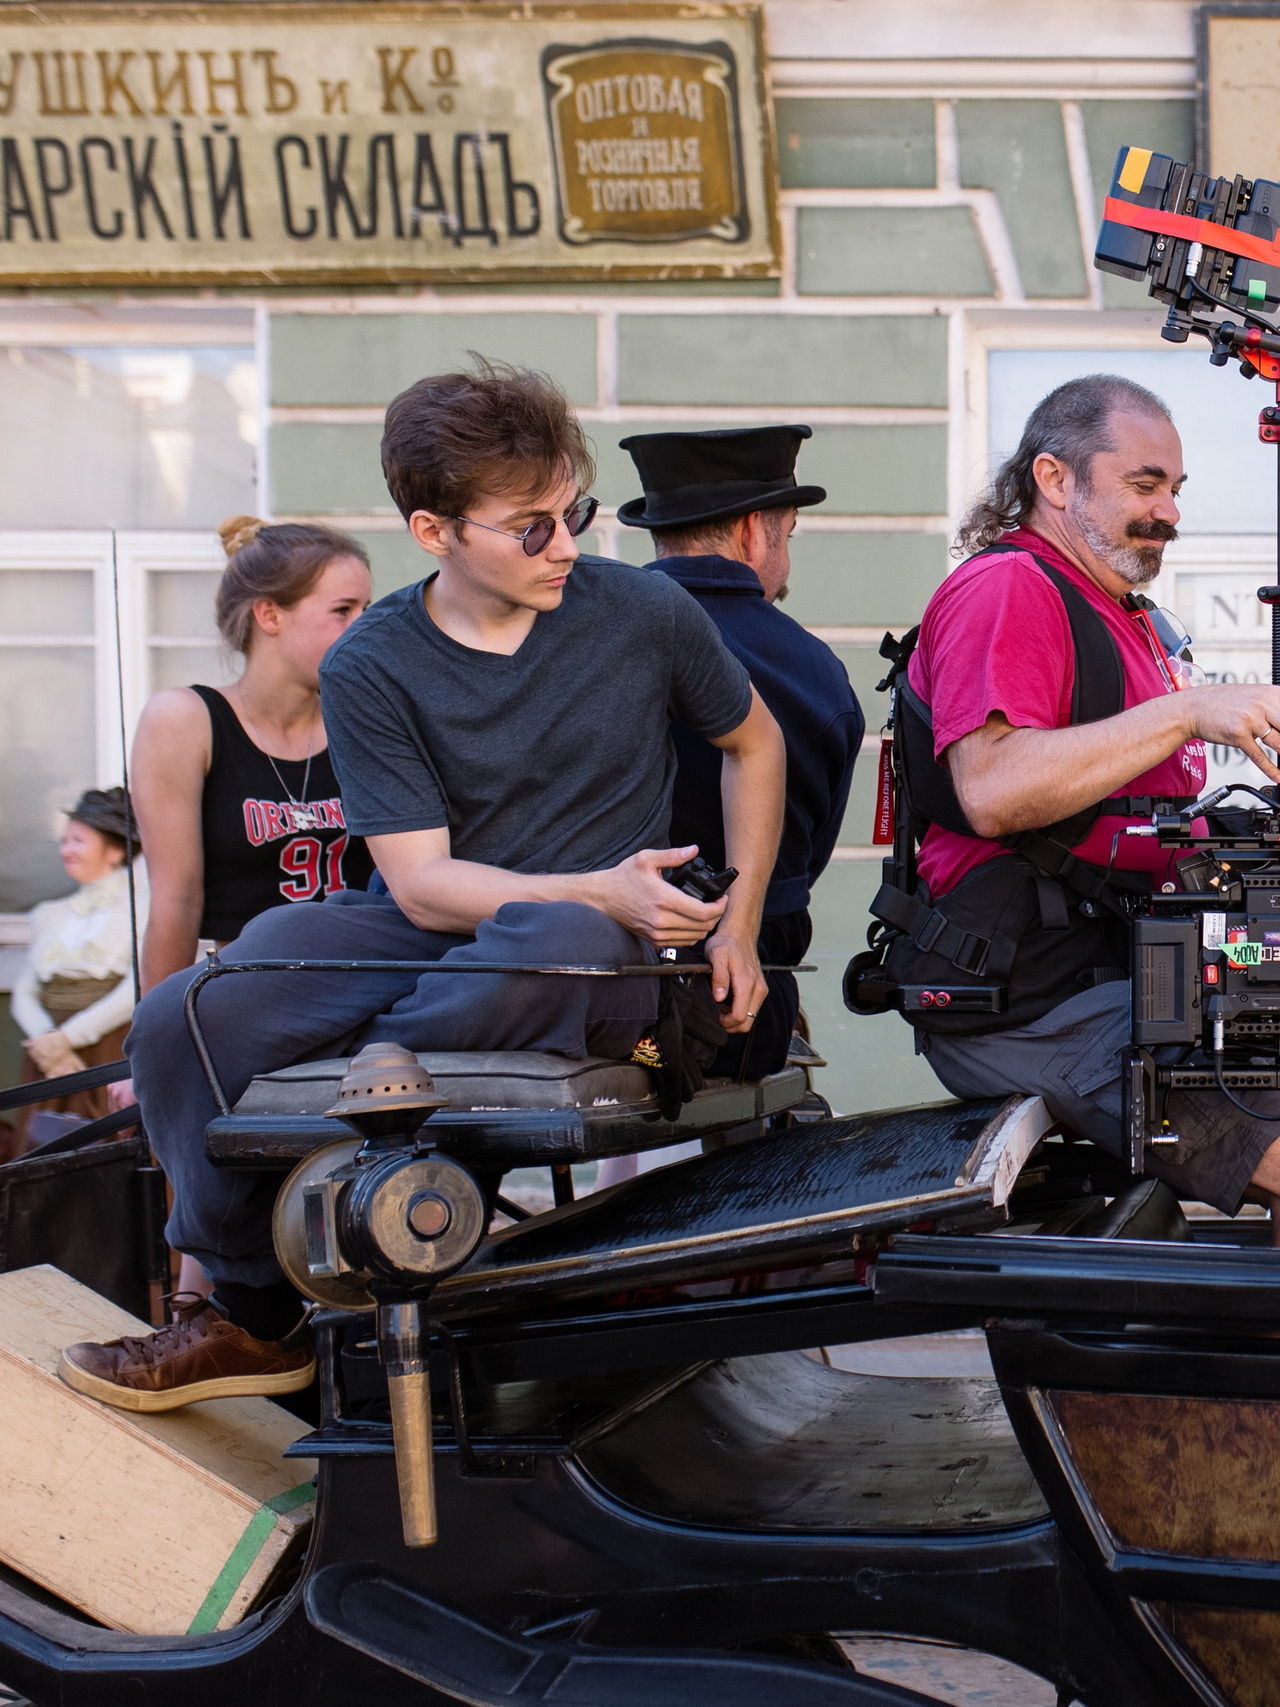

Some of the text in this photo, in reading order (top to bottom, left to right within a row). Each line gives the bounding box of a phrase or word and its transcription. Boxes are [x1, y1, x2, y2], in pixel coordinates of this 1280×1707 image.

[575, 74, 704, 123] ОПТОВАЯ
[575, 137, 703, 175] РОЗНИЧНАЯ
[274, 131, 541, 247] СКЛАДЪ
[586, 177, 704, 212] ТОРГОВЛЯ
[883, 771, 890, 782] ME
[882, 783, 890, 810] BEFORE
[880, 811, 890, 836] FLIGHT
[279, 837, 349, 902] 91
